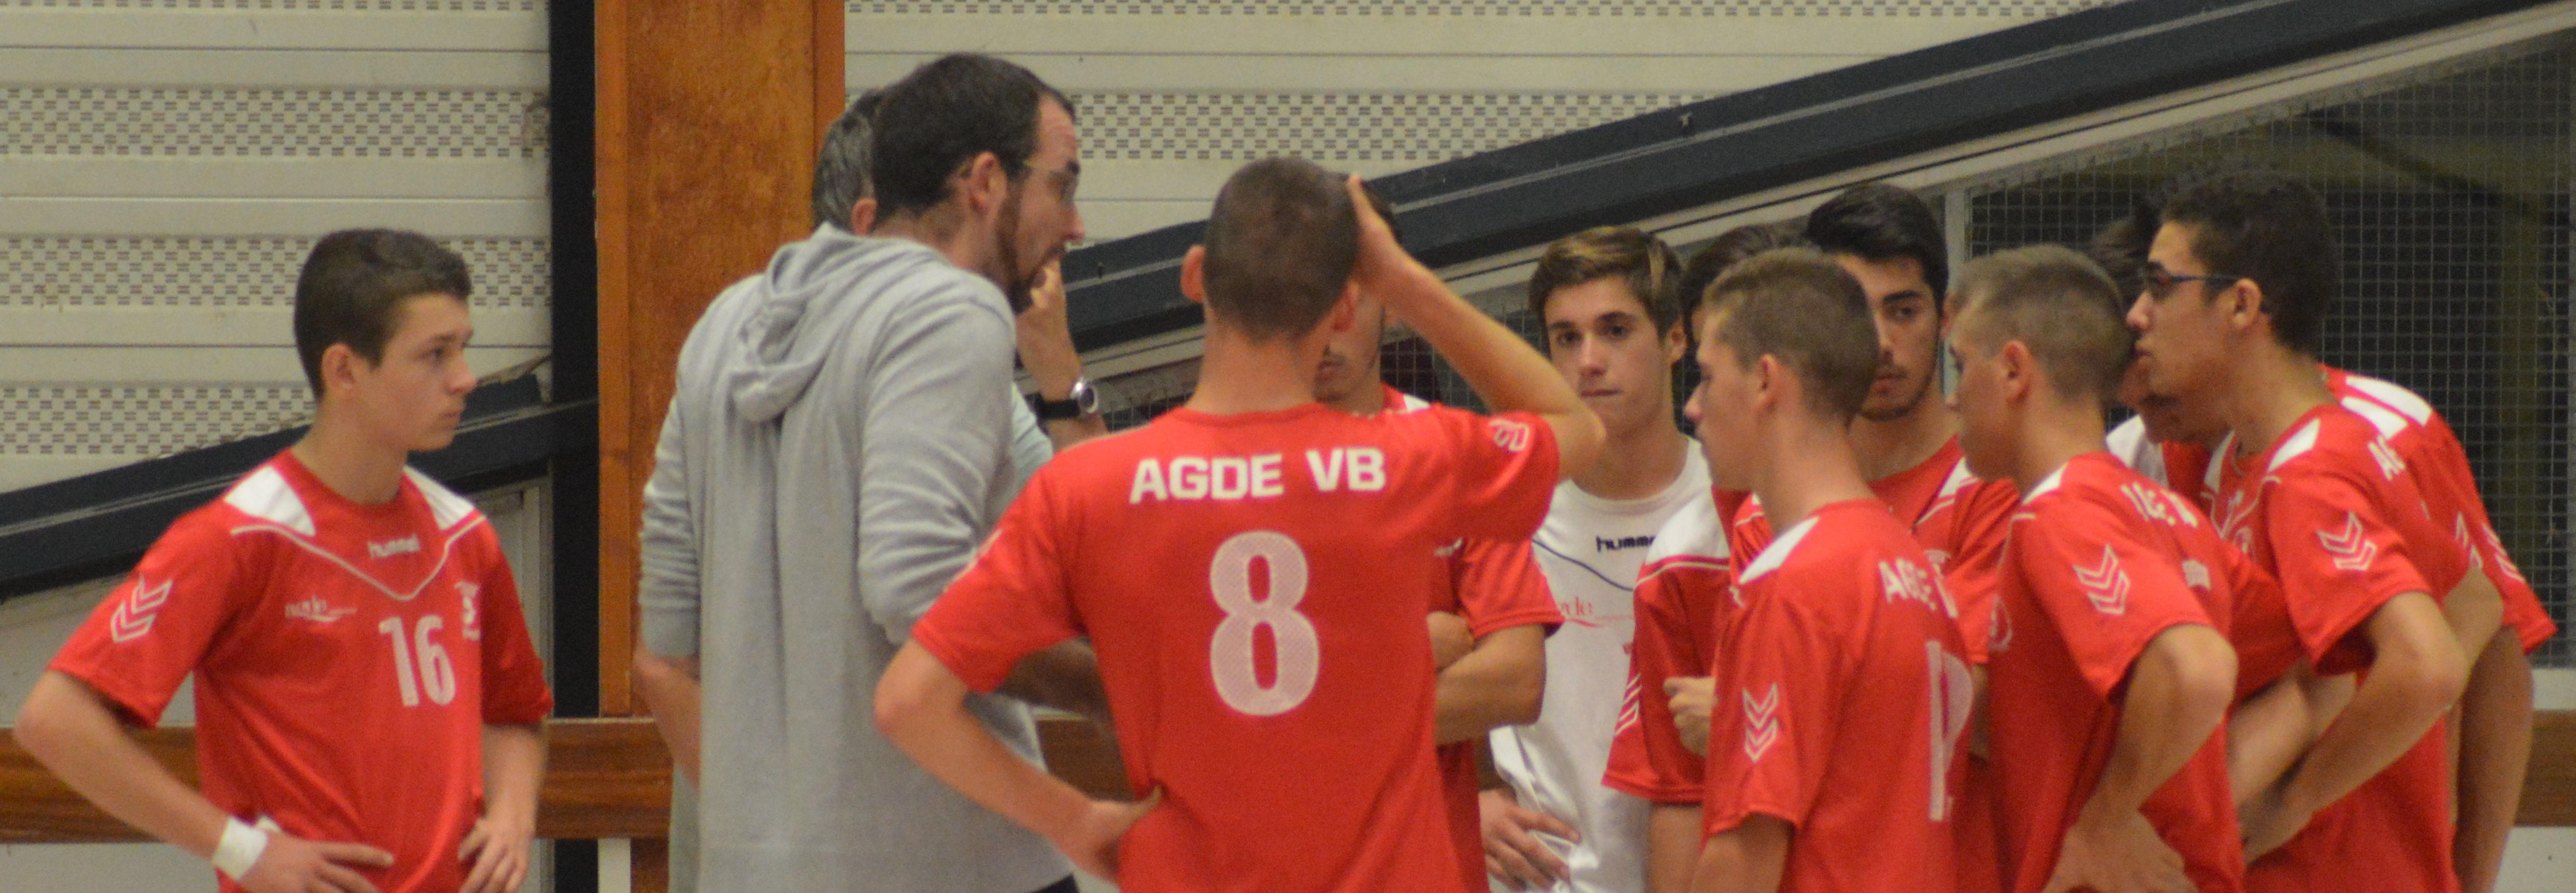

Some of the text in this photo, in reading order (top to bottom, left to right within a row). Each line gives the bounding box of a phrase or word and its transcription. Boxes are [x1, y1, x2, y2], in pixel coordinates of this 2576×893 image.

[1129, 446, 1387, 503] AGDE VB
[378, 614, 457, 707] 16
[1209, 529, 1320, 716] 8
